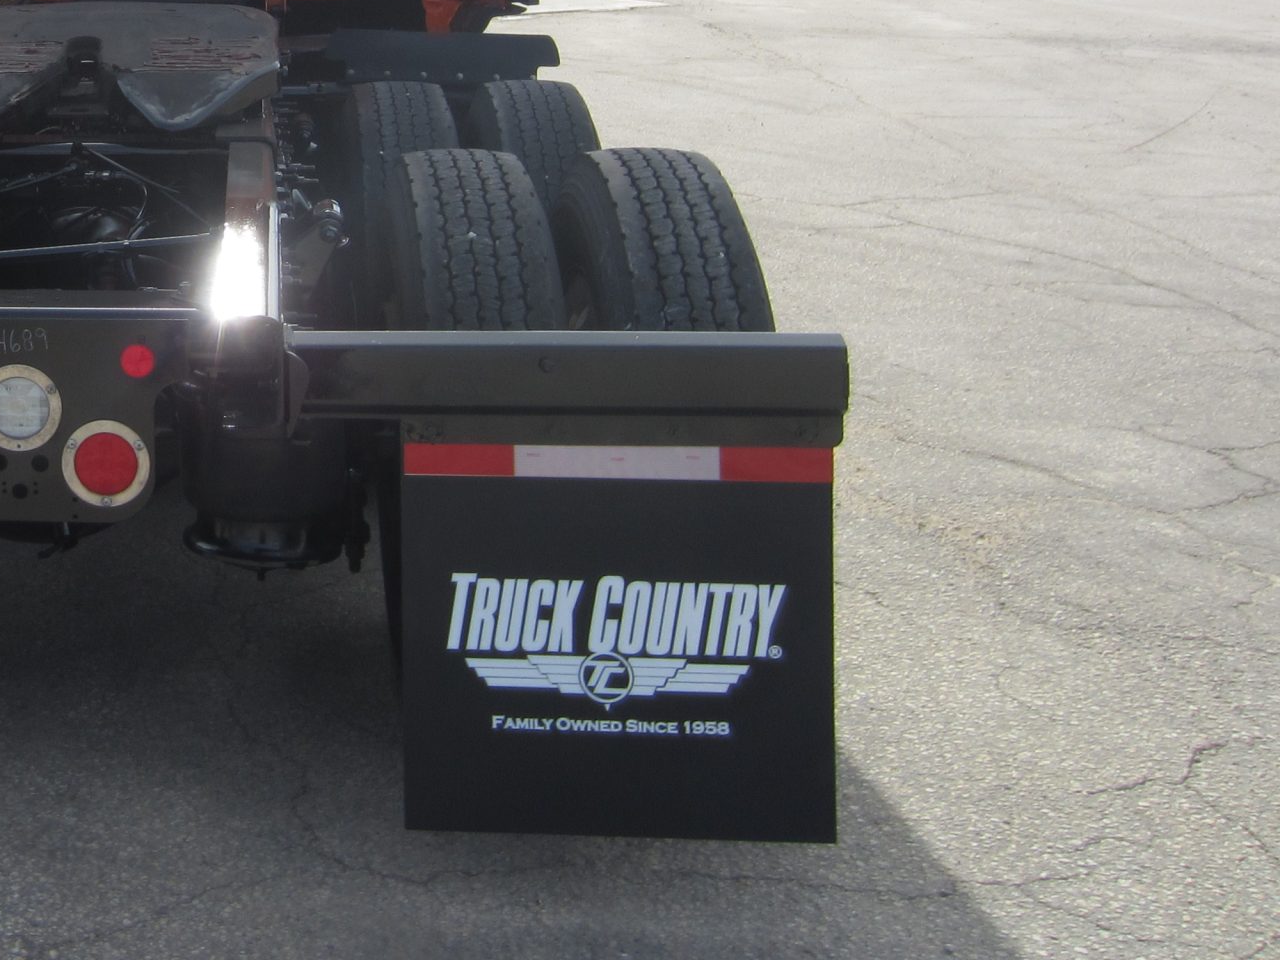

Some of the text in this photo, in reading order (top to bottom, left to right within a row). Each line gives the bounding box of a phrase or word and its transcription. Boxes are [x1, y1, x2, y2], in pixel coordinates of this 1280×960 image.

[446, 572, 584, 653] TRUCK
[491, 714, 730, 736] FAMILY OWNED SINCE 1958
